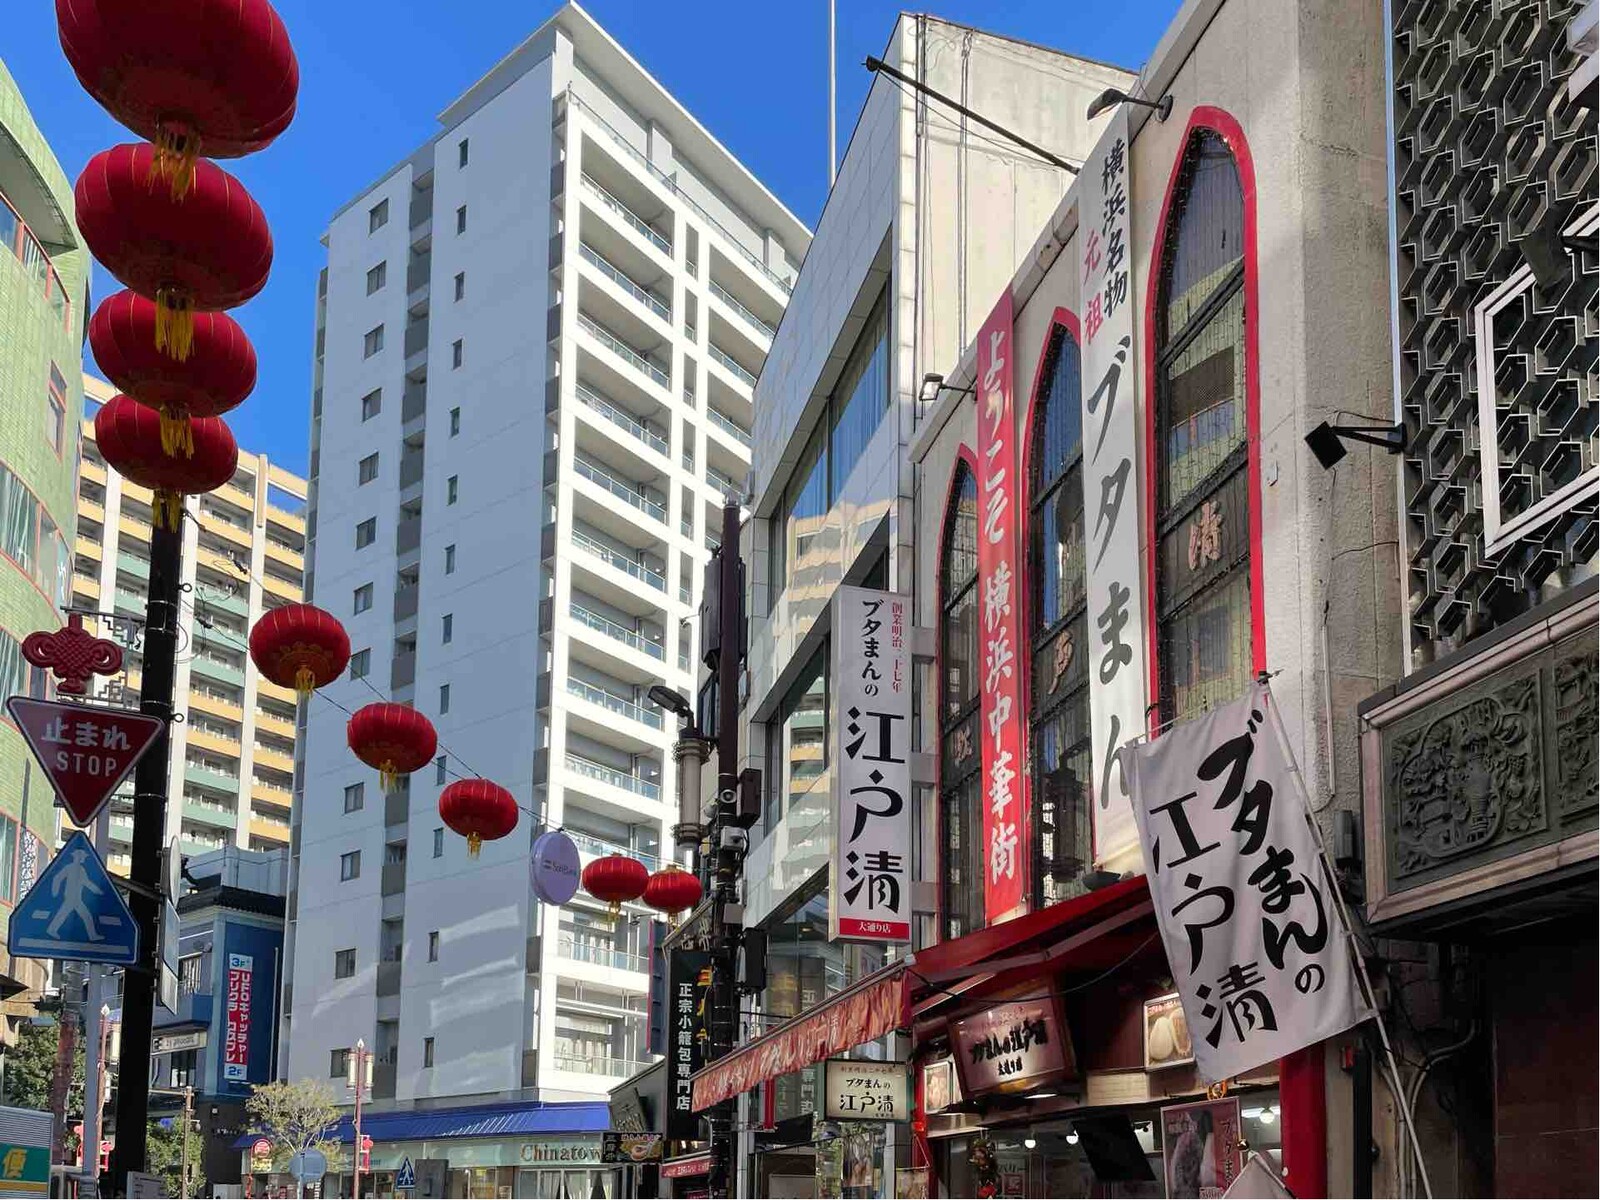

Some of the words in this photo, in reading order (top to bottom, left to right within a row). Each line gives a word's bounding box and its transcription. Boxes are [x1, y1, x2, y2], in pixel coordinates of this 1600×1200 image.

[1101, 137, 1128, 318] 横浜名物
[1083, 229, 1104, 345] 元祖
[983, 330, 1009, 545] ようこそ
[861, 598, 885, 698] ブタまんの
[42, 717, 132, 750] 止まれ
[56, 751, 119, 777] STOP
[984, 560, 1018, 885] 横浜中華街
[1196, 709, 1329, 995] ブタまんの
[227, 1066, 243, 1076] 2F
[839, 1092, 894, 1113] 江戸清
[846, 1078, 891, 1089] ブタまんの
